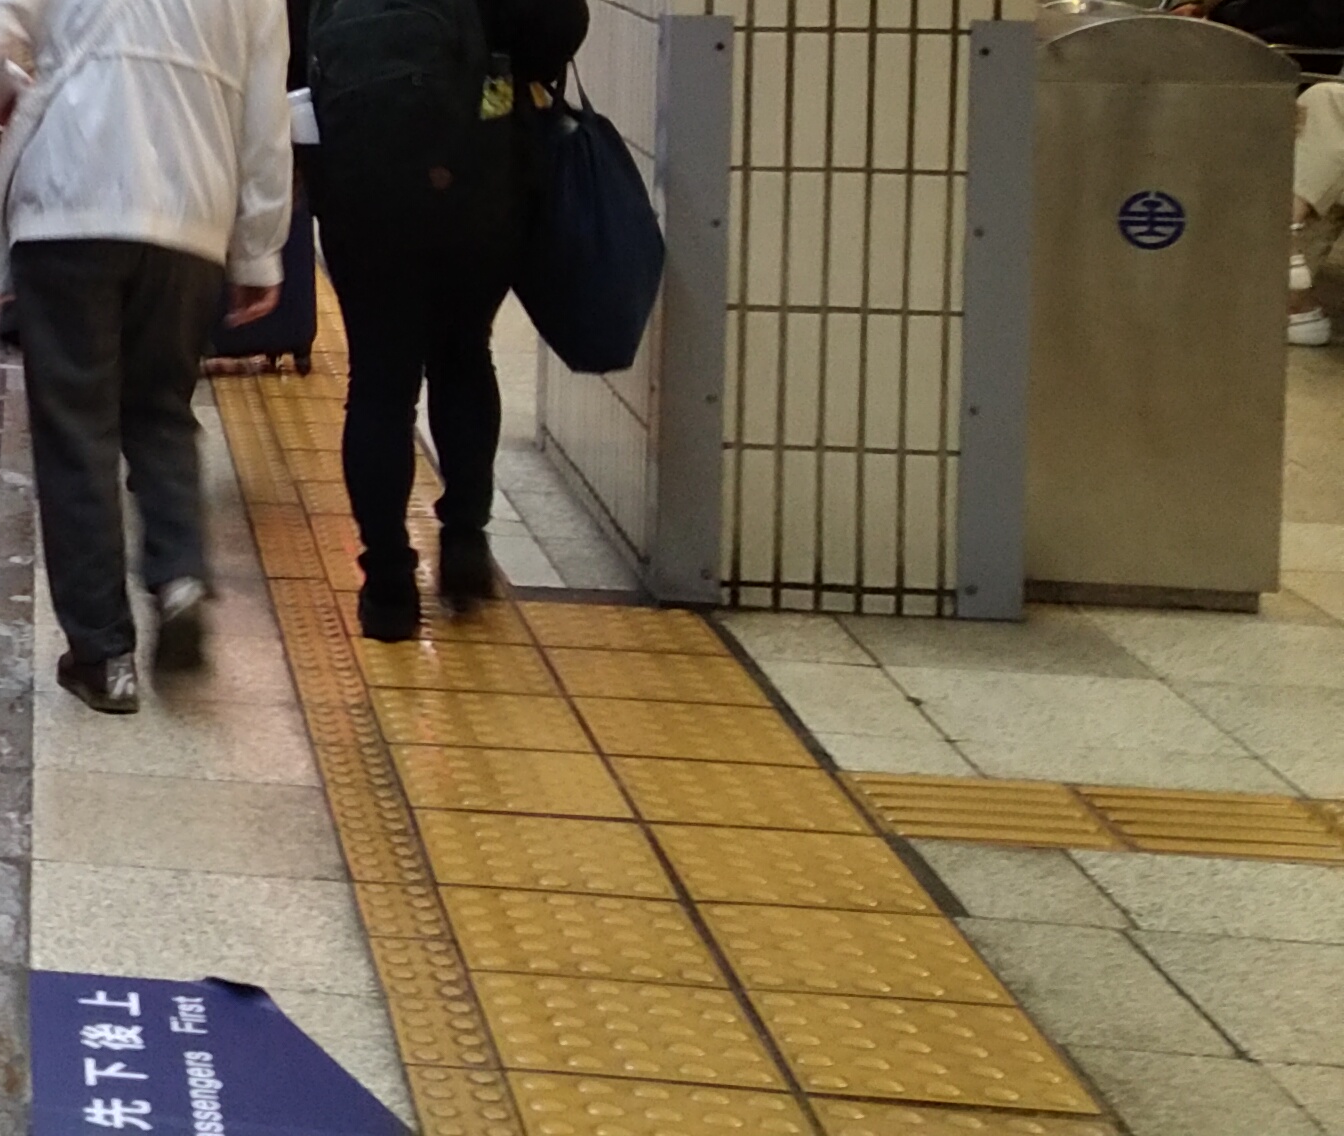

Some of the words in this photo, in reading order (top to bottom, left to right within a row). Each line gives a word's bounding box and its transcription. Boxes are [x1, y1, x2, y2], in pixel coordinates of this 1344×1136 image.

[169, 995, 209, 1034] First
[77, 990, 154, 1131] 先下後上
